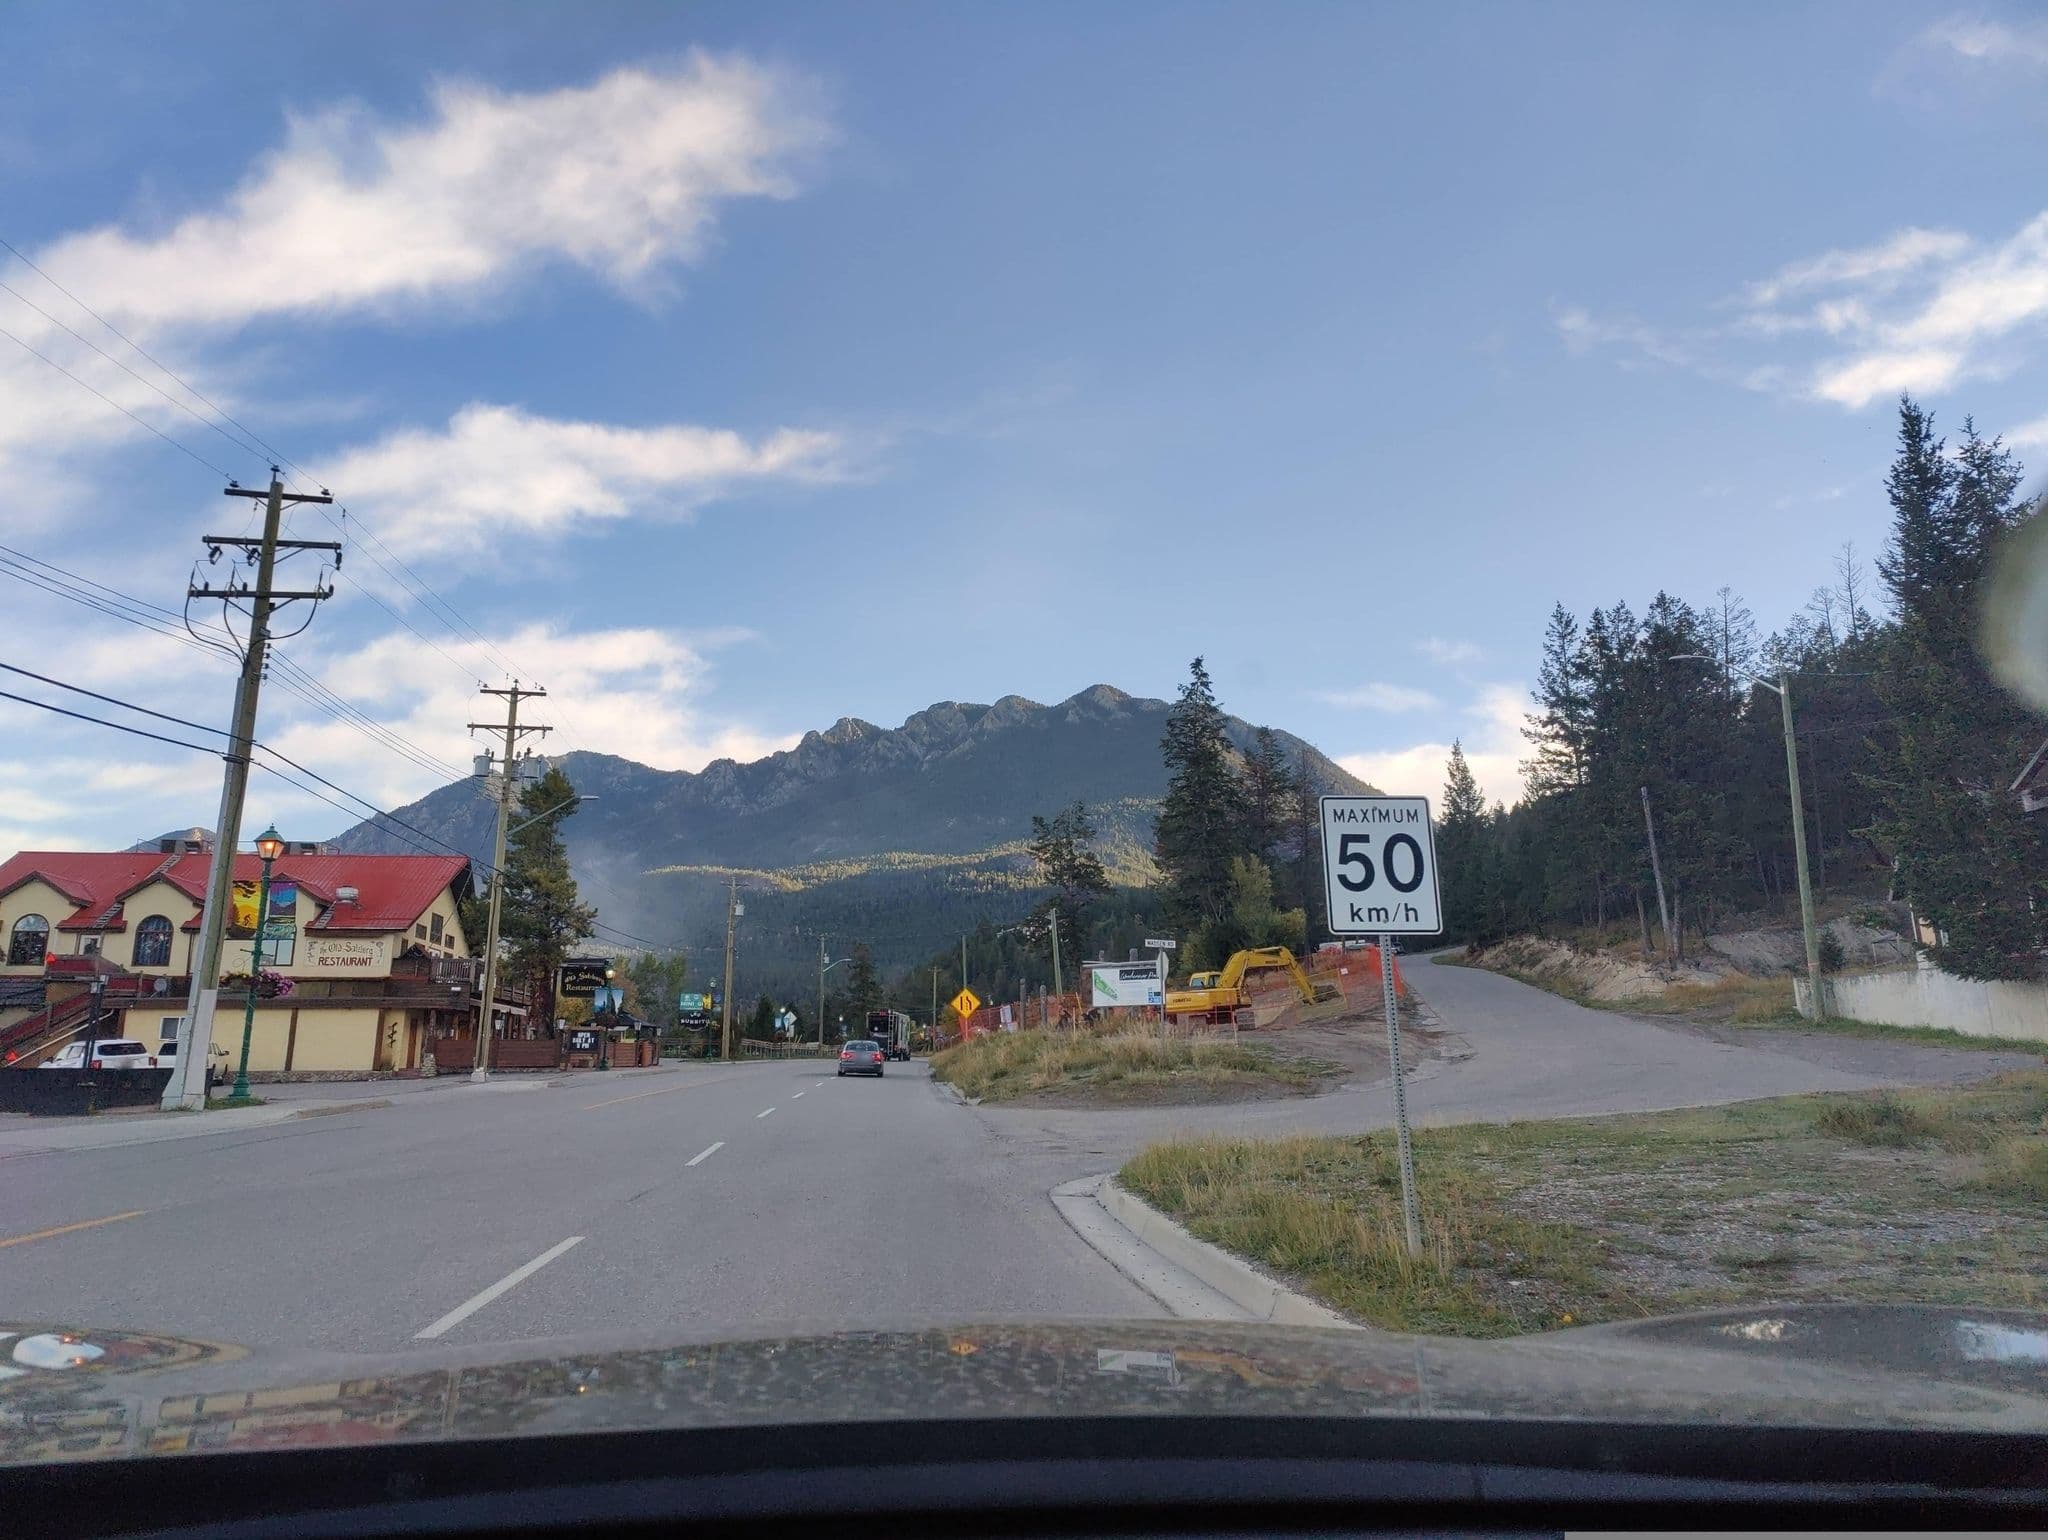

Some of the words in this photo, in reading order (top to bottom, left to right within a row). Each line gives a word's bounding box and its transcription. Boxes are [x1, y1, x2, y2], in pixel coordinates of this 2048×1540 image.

[1333, 808, 1419, 823] MAXIMUM
[1337, 833, 1424, 893] 50
[1350, 902, 1419, 923] km/h
[328, 943, 343, 952] Old
[318, 956, 374, 966] RESTAURANT
